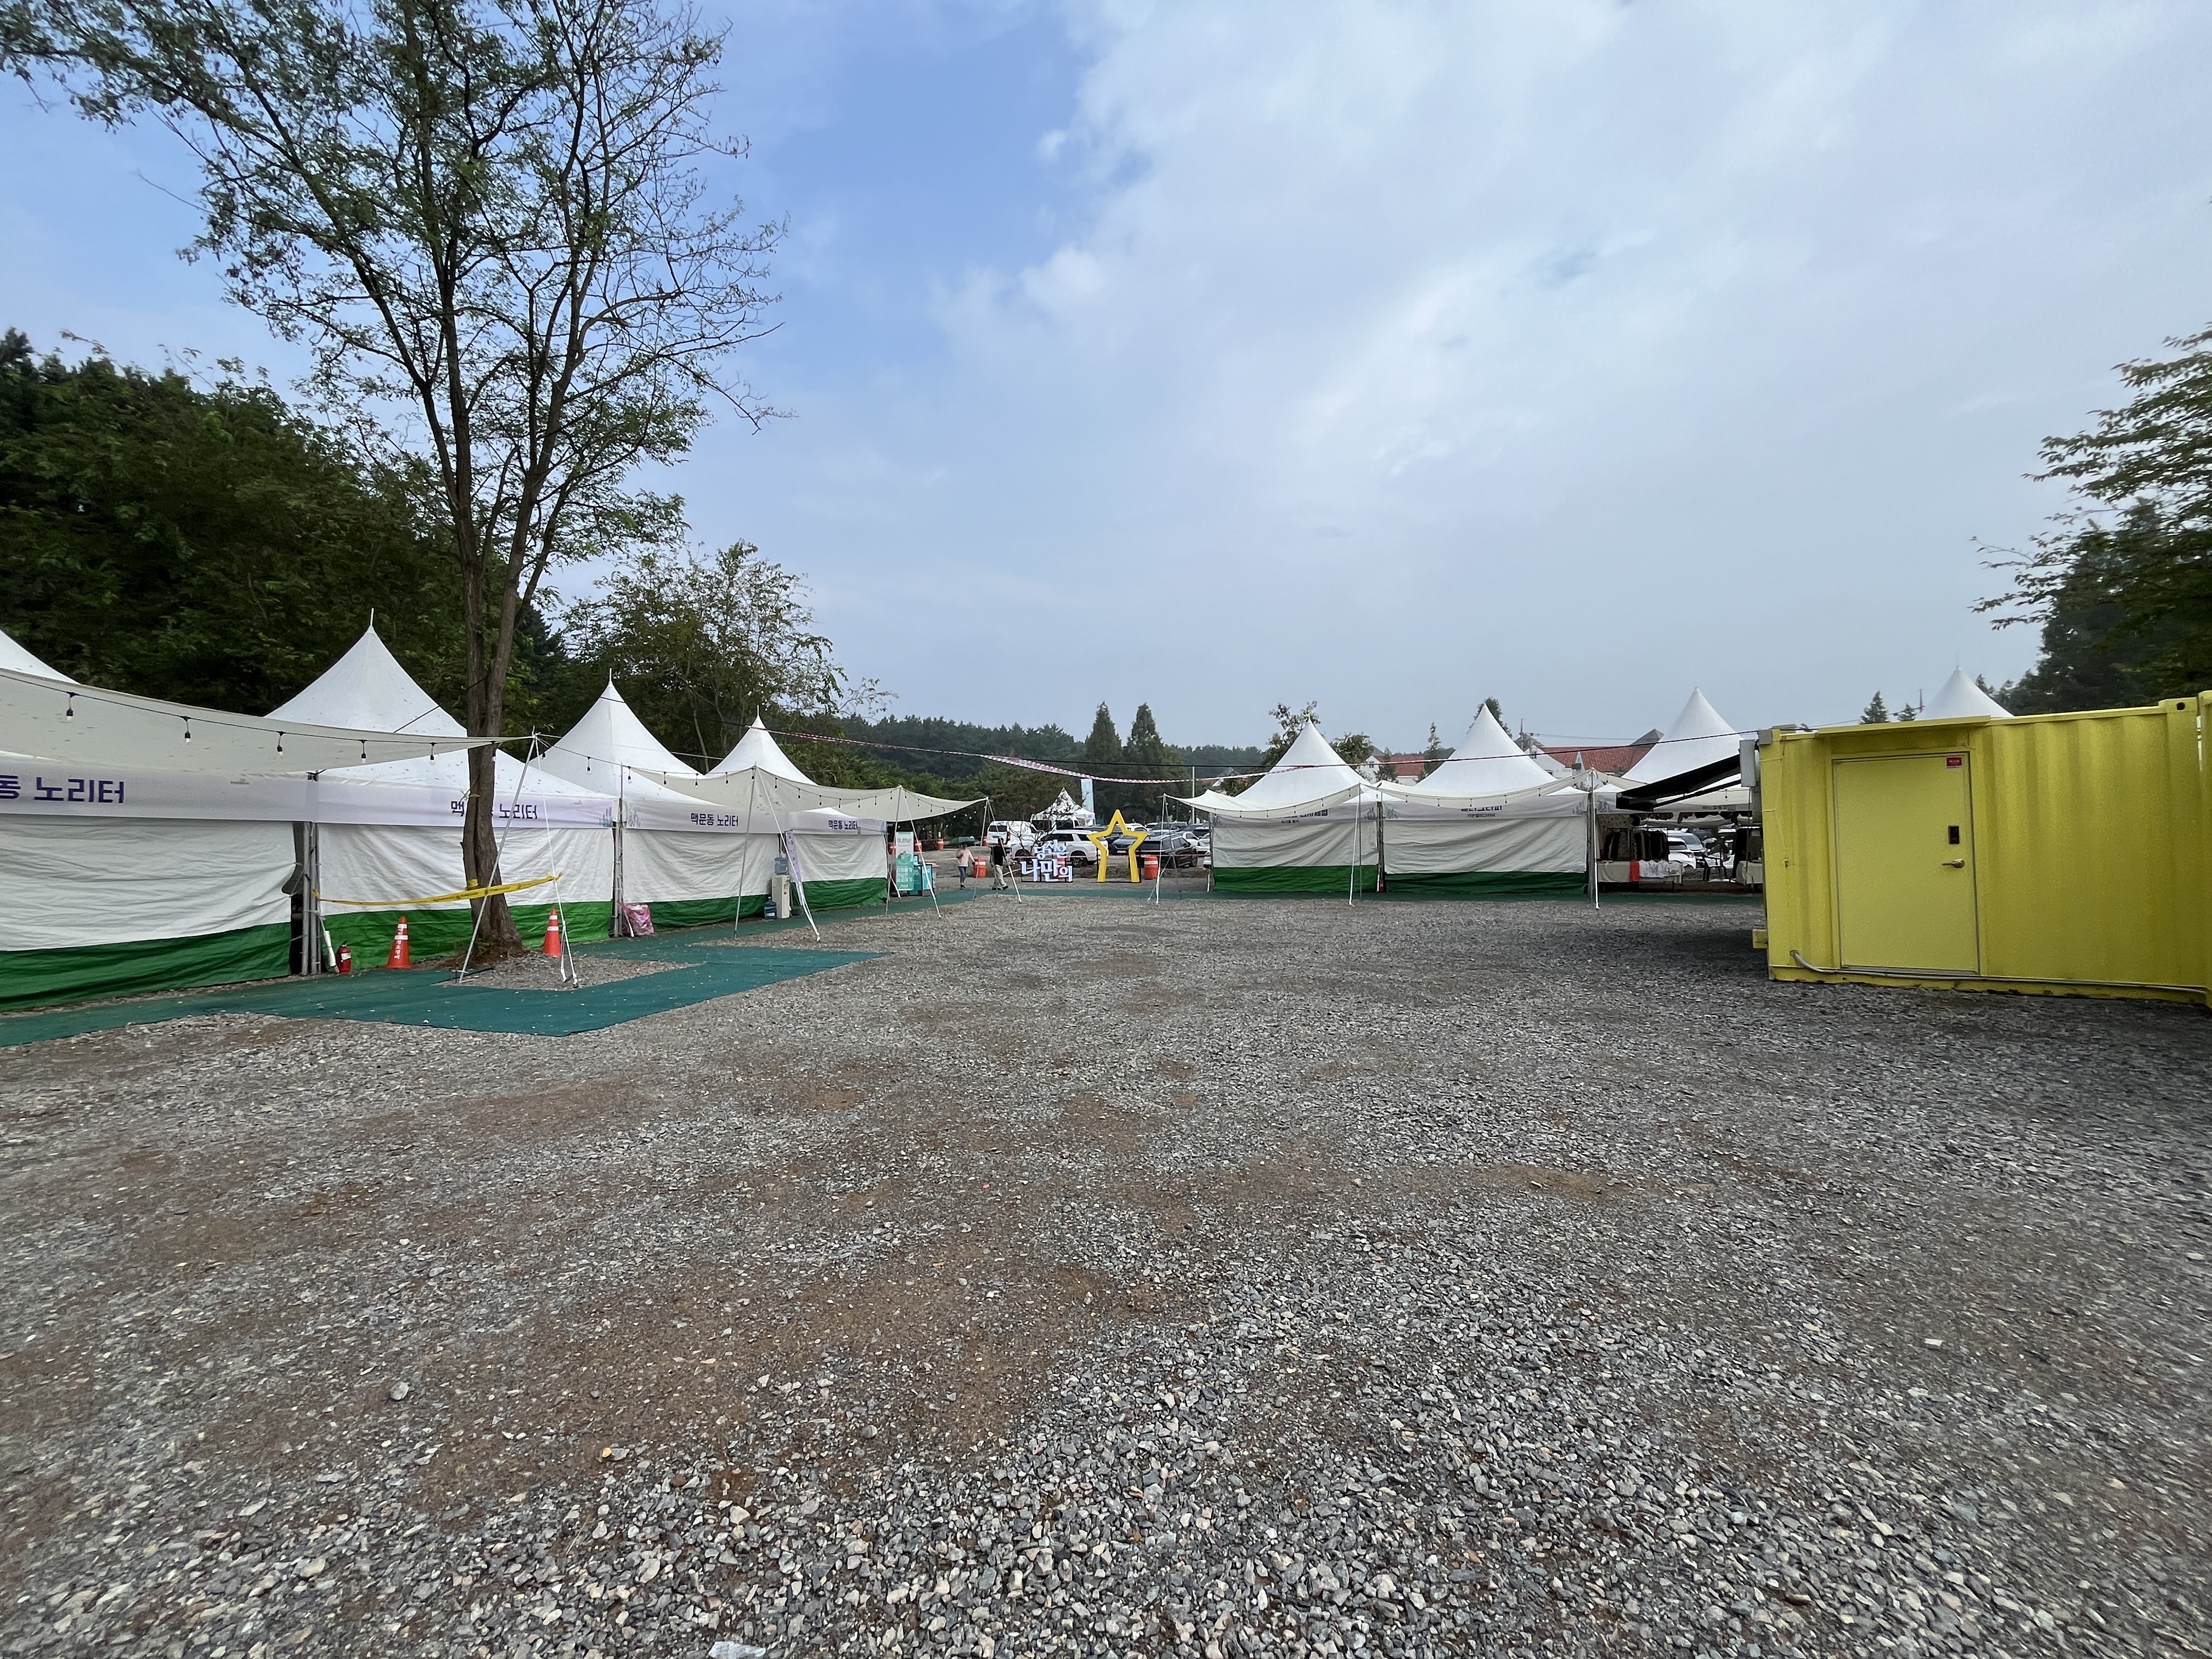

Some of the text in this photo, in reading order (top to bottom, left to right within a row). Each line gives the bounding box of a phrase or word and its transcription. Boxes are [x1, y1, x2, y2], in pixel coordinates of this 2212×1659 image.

[33, 777, 125, 803] 노리터
[499, 804, 537, 820] 노리터
[691, 812, 738, 827] 맥문동 노리터
[828, 820, 857, 830] 맥문동 노리터
[1033, 839, 1069, 860] 당신은
[1020, 859, 1073, 882] 나만의
